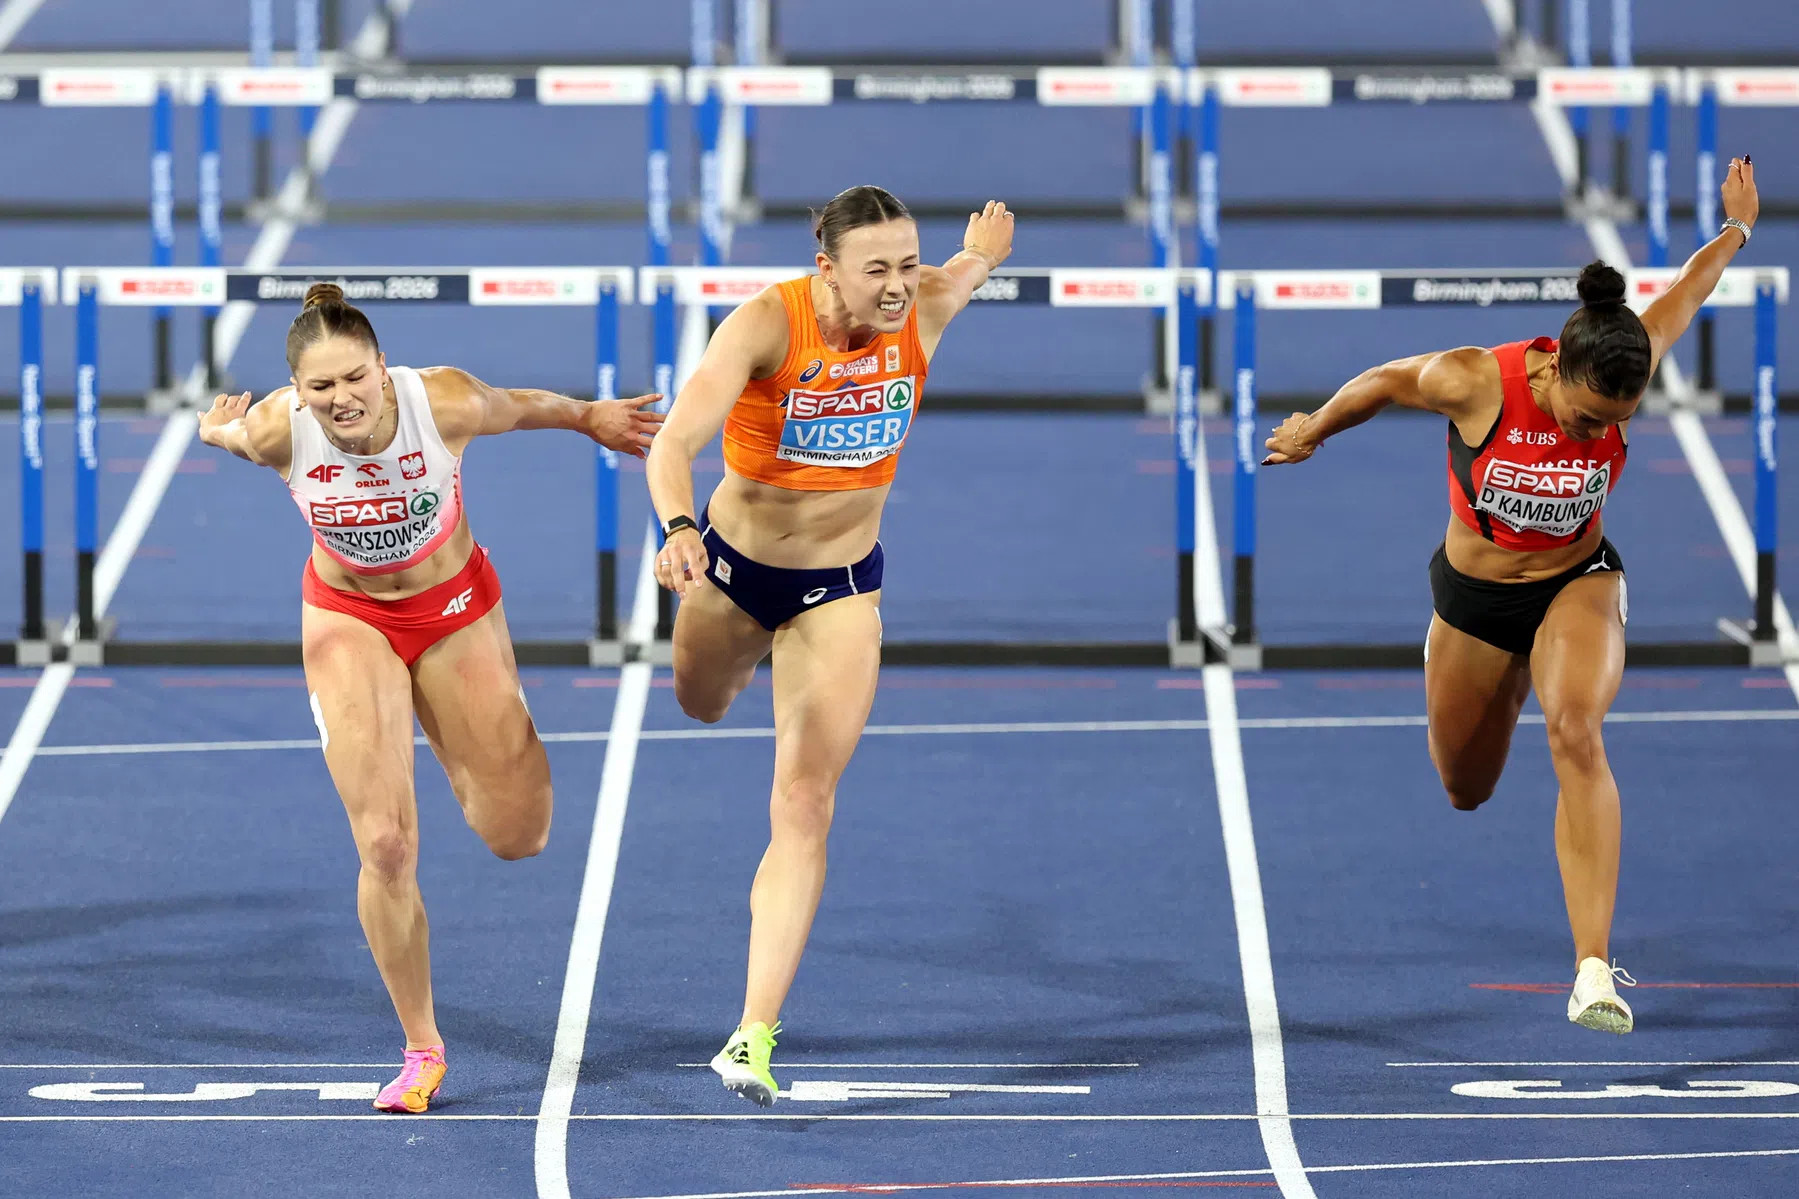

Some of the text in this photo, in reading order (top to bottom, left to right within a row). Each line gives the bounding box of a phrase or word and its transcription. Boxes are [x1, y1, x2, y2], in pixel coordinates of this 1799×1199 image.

[258, 276, 439, 299] Birmham 2026
[1414, 277, 1580, 307] Birmingham 202
[846, 355, 878, 370] STAATS
[794, 389, 882, 417] SPAR
[794, 417, 902, 448] VISSER
[1526, 431, 1557, 446] UBS
[783, 448, 872, 462] BIRMINGHAM
[306, 464, 345, 483] 4F
[355, 479, 390, 489] ORLEN
[1490, 467, 1582, 495] SPAR
[1481, 487, 1495, 504] D
[312, 501, 406, 525] SPAR
[327, 526, 436, 563] BIRMINGHAM 2026
[441, 587, 473, 617] 4F
